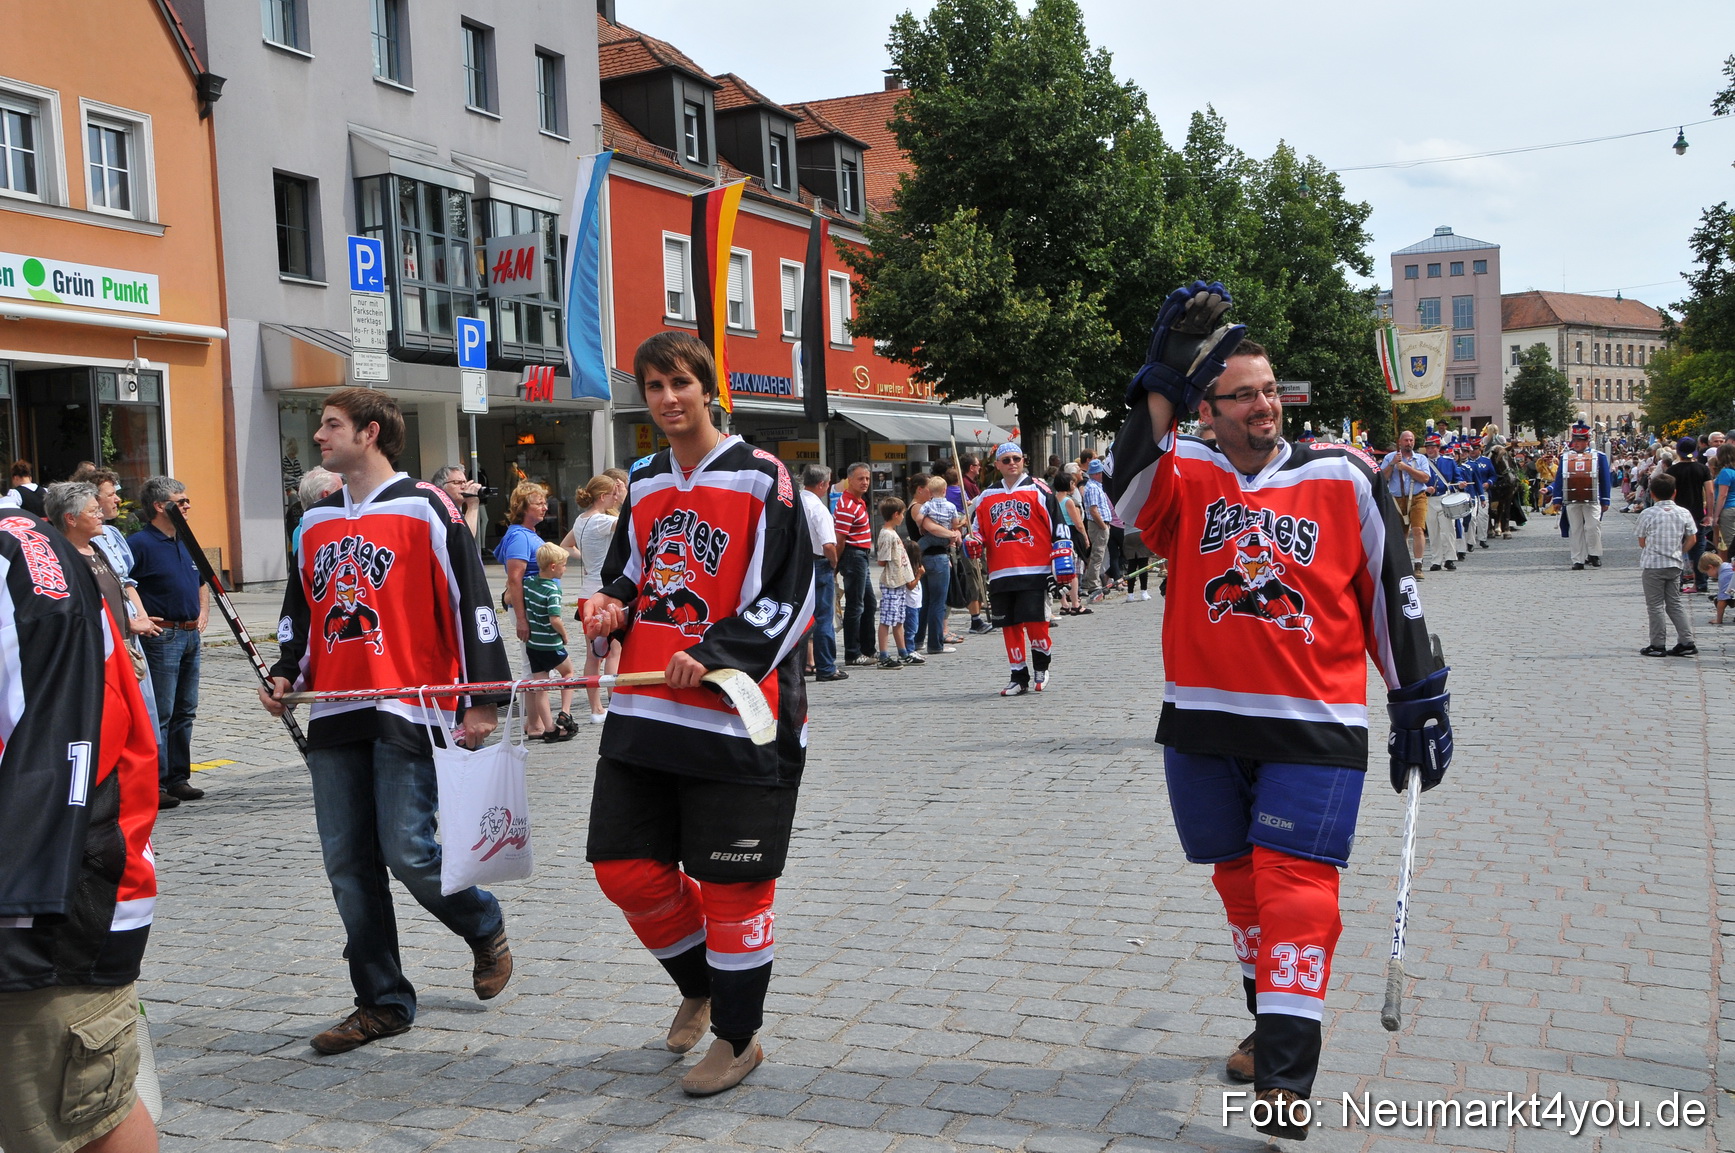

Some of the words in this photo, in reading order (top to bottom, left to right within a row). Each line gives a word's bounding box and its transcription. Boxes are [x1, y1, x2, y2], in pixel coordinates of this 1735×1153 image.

[355, 243, 376, 285] P
[492, 245, 535, 284] H&M
[0, 266, 15, 288] n
[52, 269, 95, 298] Grün
[101, 276, 150, 305] Punkt
[353, 306, 384, 317] Parkschein
[355, 317, 382, 327] werktags
[463, 324, 480, 361] P
[524, 365, 556, 404] H&M
[989, 499, 1031, 525] Eagles
[1055, 523, 1071, 540] 40
[312, 535, 395, 603] Eagles
[1400, 575, 1426, 619] 3
[68, 742, 91, 806] 1
[1258, 811, 1295, 831] CCM
[710, 851, 763, 863] BAUER
[1270, 941, 1327, 993] 33
